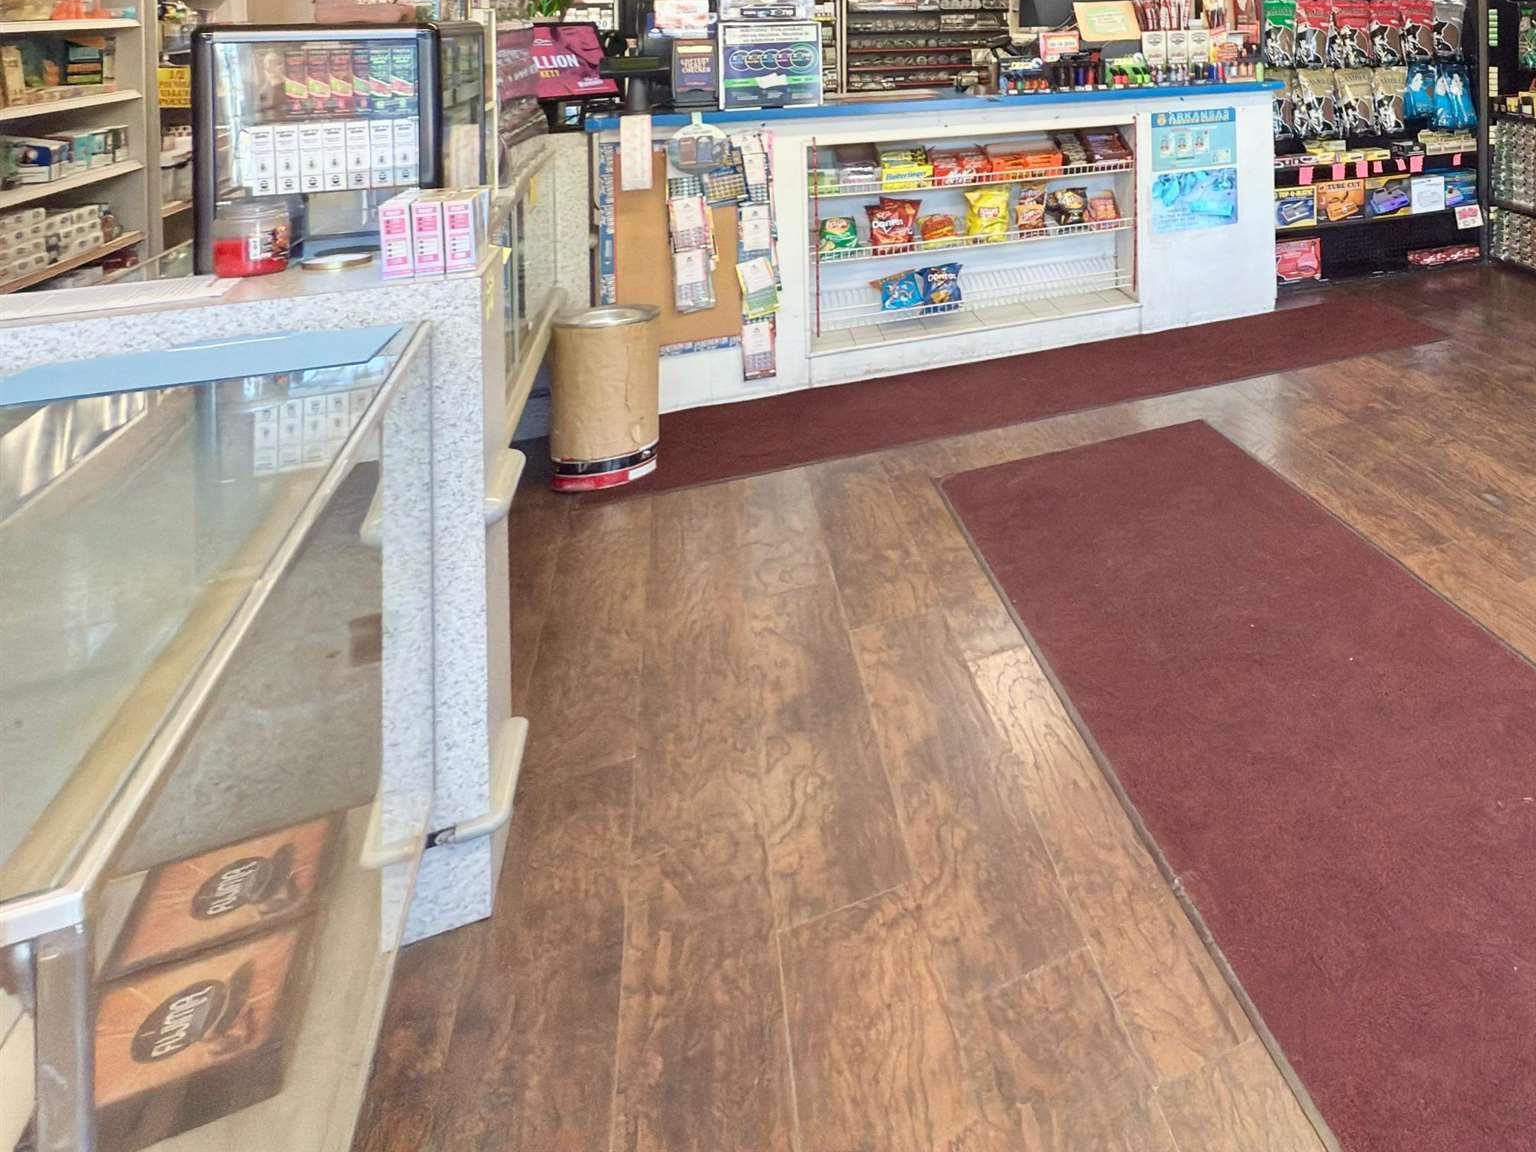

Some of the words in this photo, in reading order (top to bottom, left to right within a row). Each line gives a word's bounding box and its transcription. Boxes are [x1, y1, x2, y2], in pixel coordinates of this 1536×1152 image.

[533, 54, 579, 68] LLION
[872, 218, 904, 229] Doritos
[928, 273, 957, 282] Doritos
